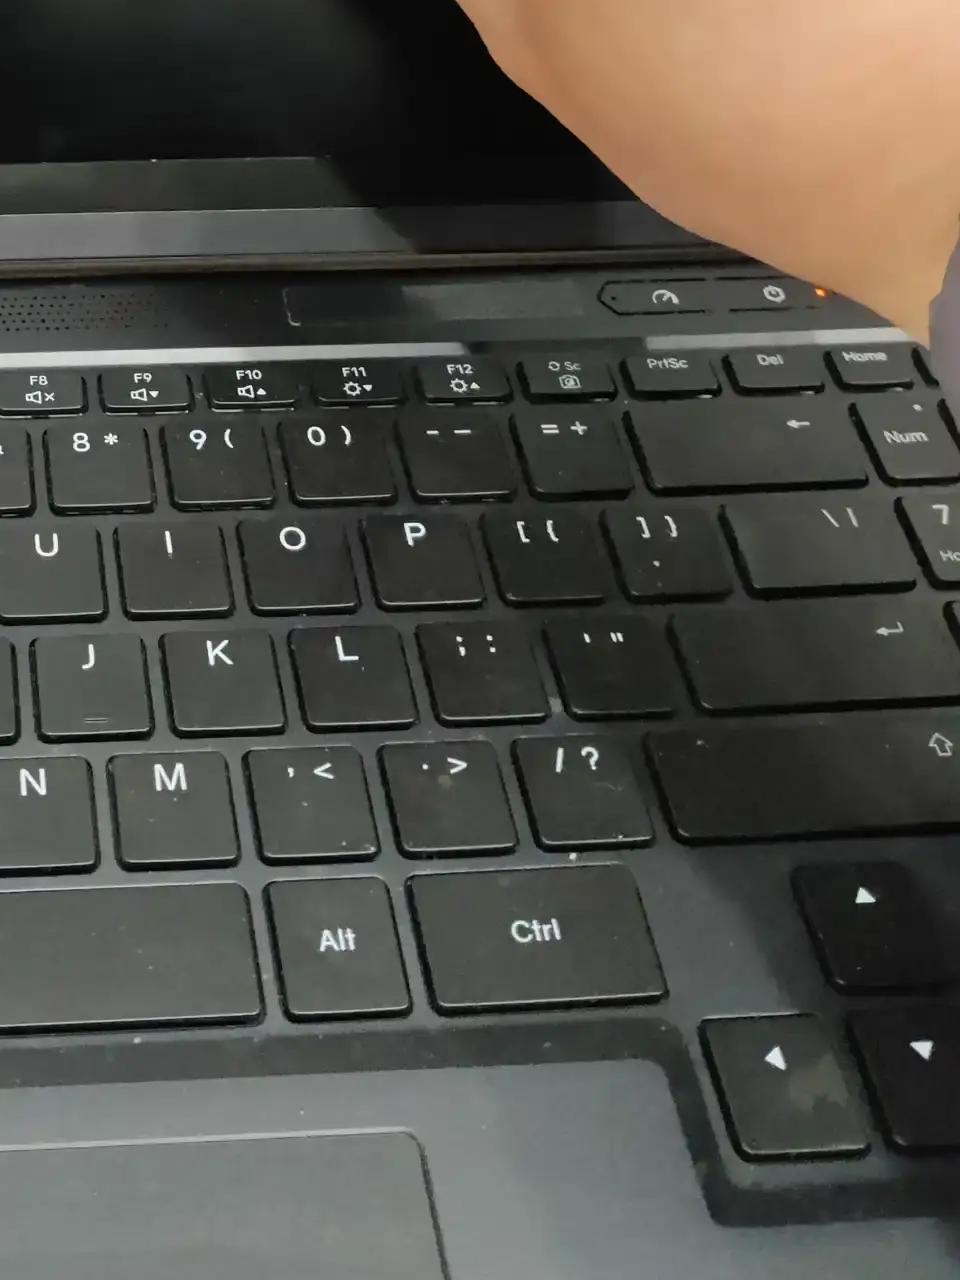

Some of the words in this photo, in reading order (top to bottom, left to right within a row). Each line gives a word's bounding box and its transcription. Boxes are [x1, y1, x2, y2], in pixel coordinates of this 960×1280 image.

[646, 357, 689, 369] PrtSc
[756, 354, 785, 366] Del
[842, 351, 888, 362] Home
[133, 372, 153, 384] F9
[235, 369, 263, 381] F10
[341, 366, 367, 378] F11
[446, 363, 473, 375] F12
[29, 375, 49, 386] F8
[72, 432, 91, 453] 8
[189, 429, 207, 451] 9
[883, 430, 929, 444] Num
[931, 504, 949, 525] 7
[34, 532, 59, 557] U
[164, 530, 173, 552] I
[279, 526, 306, 551] O
[403, 522, 426, 546] P
[81, 643, 95, 670] J
[206, 639, 234, 666] K
[334, 635, 360, 662] L
[19, 768, 47, 797] N
[153, 762, 188, 792] M
[319, 927, 356, 952] Alt
[510, 918, 562, 943] Ctrl
